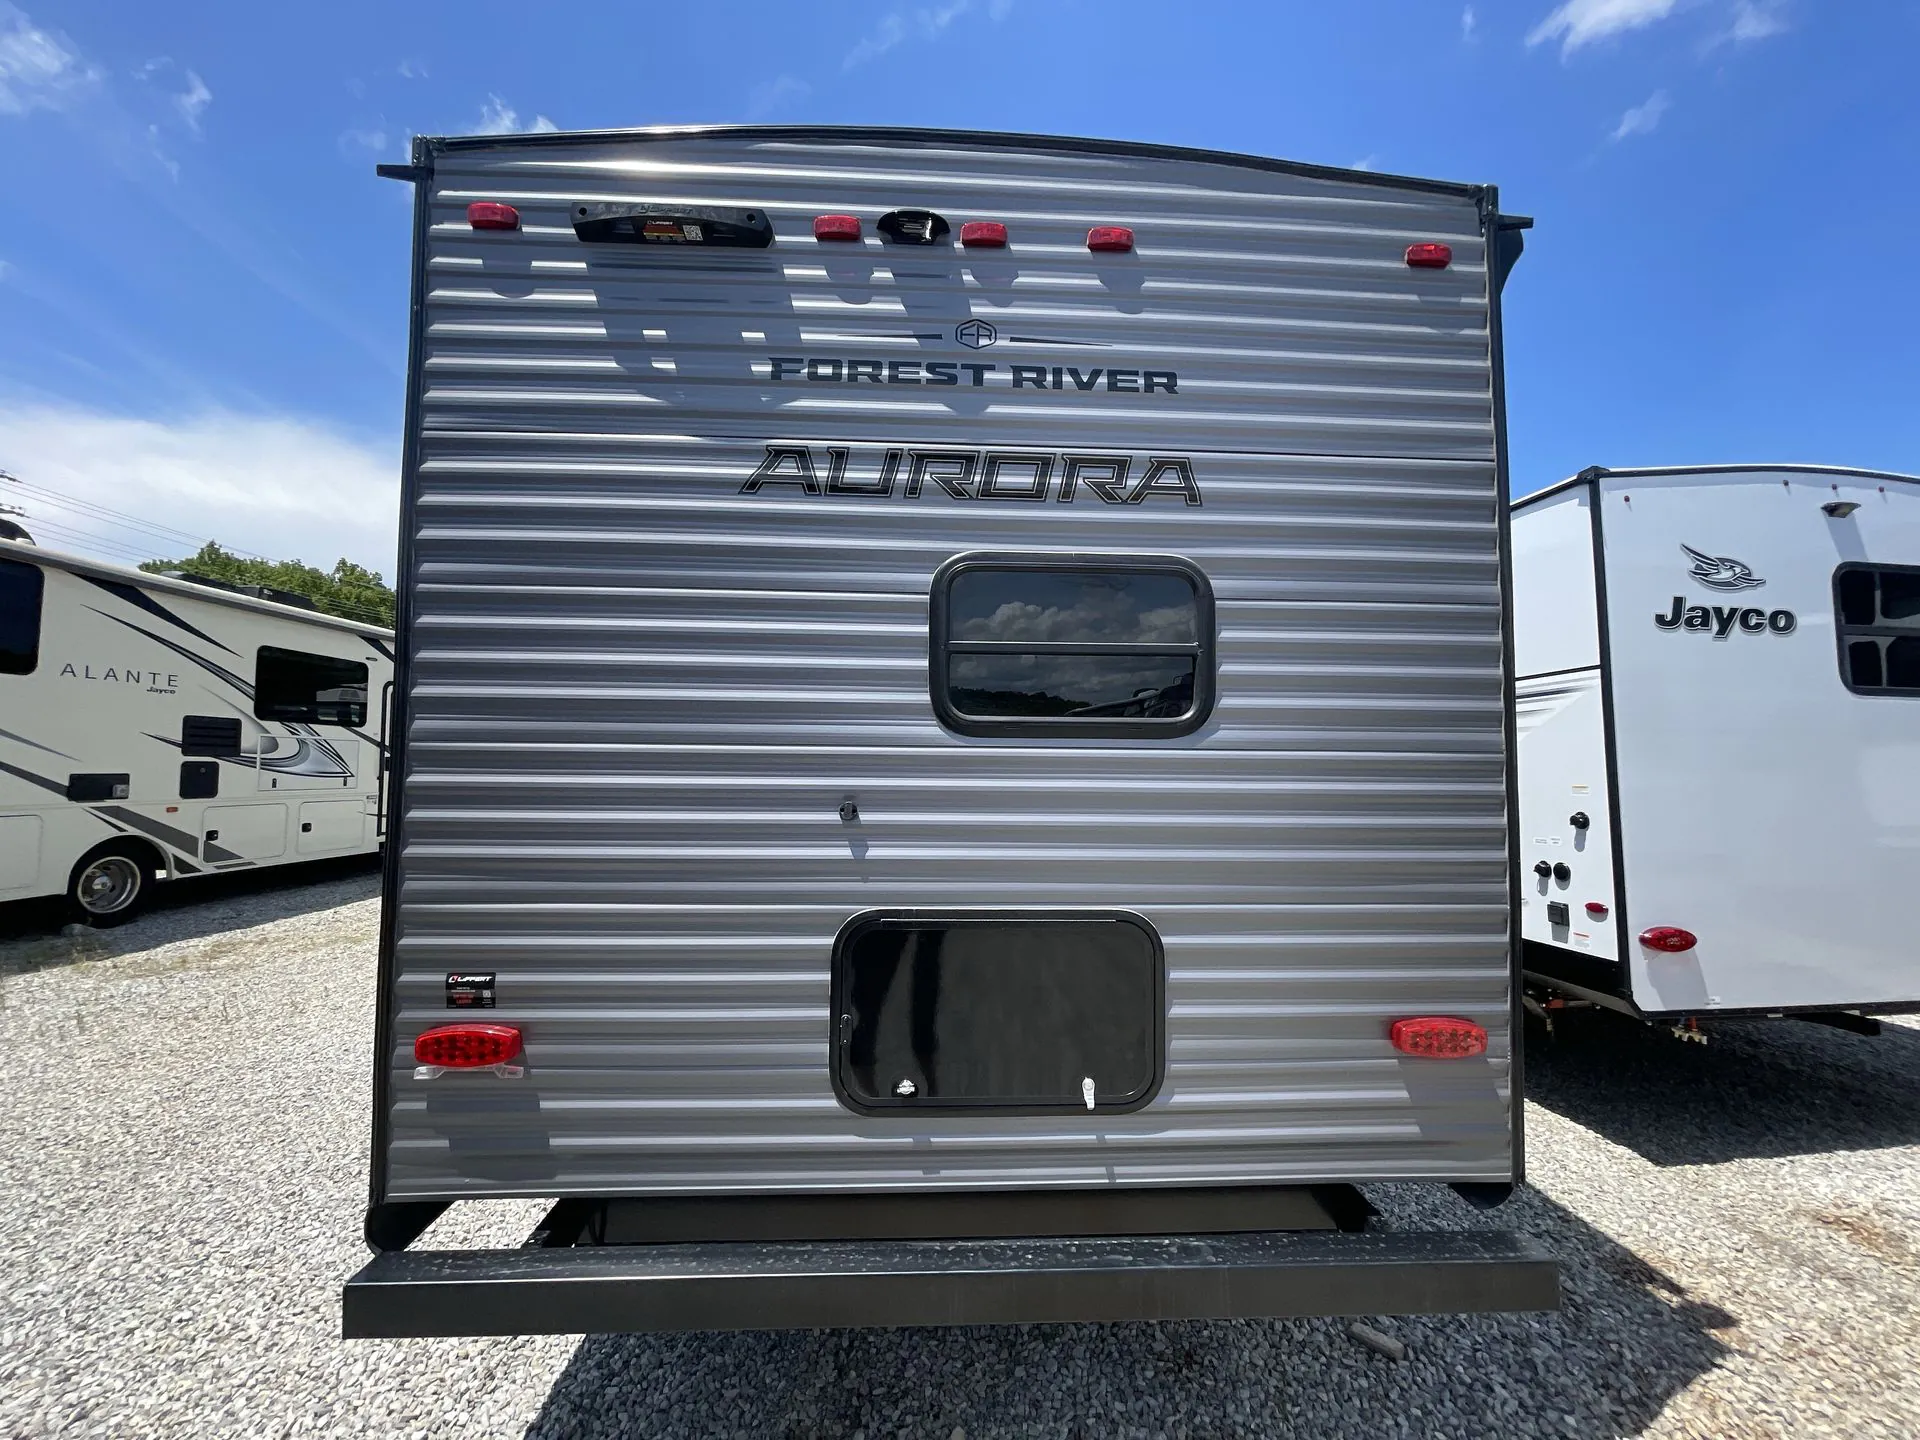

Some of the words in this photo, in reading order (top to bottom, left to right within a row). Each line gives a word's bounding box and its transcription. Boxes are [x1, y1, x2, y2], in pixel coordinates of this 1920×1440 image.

[768, 357, 996, 387] FOREST
[1010, 364, 1179, 394] RIVER
[738, 445, 1203, 507] AURORA
[1654, 595, 1797, 639] Jayco
[60, 663, 179, 687] ALANTE
[146, 686, 176, 695] Jayco
